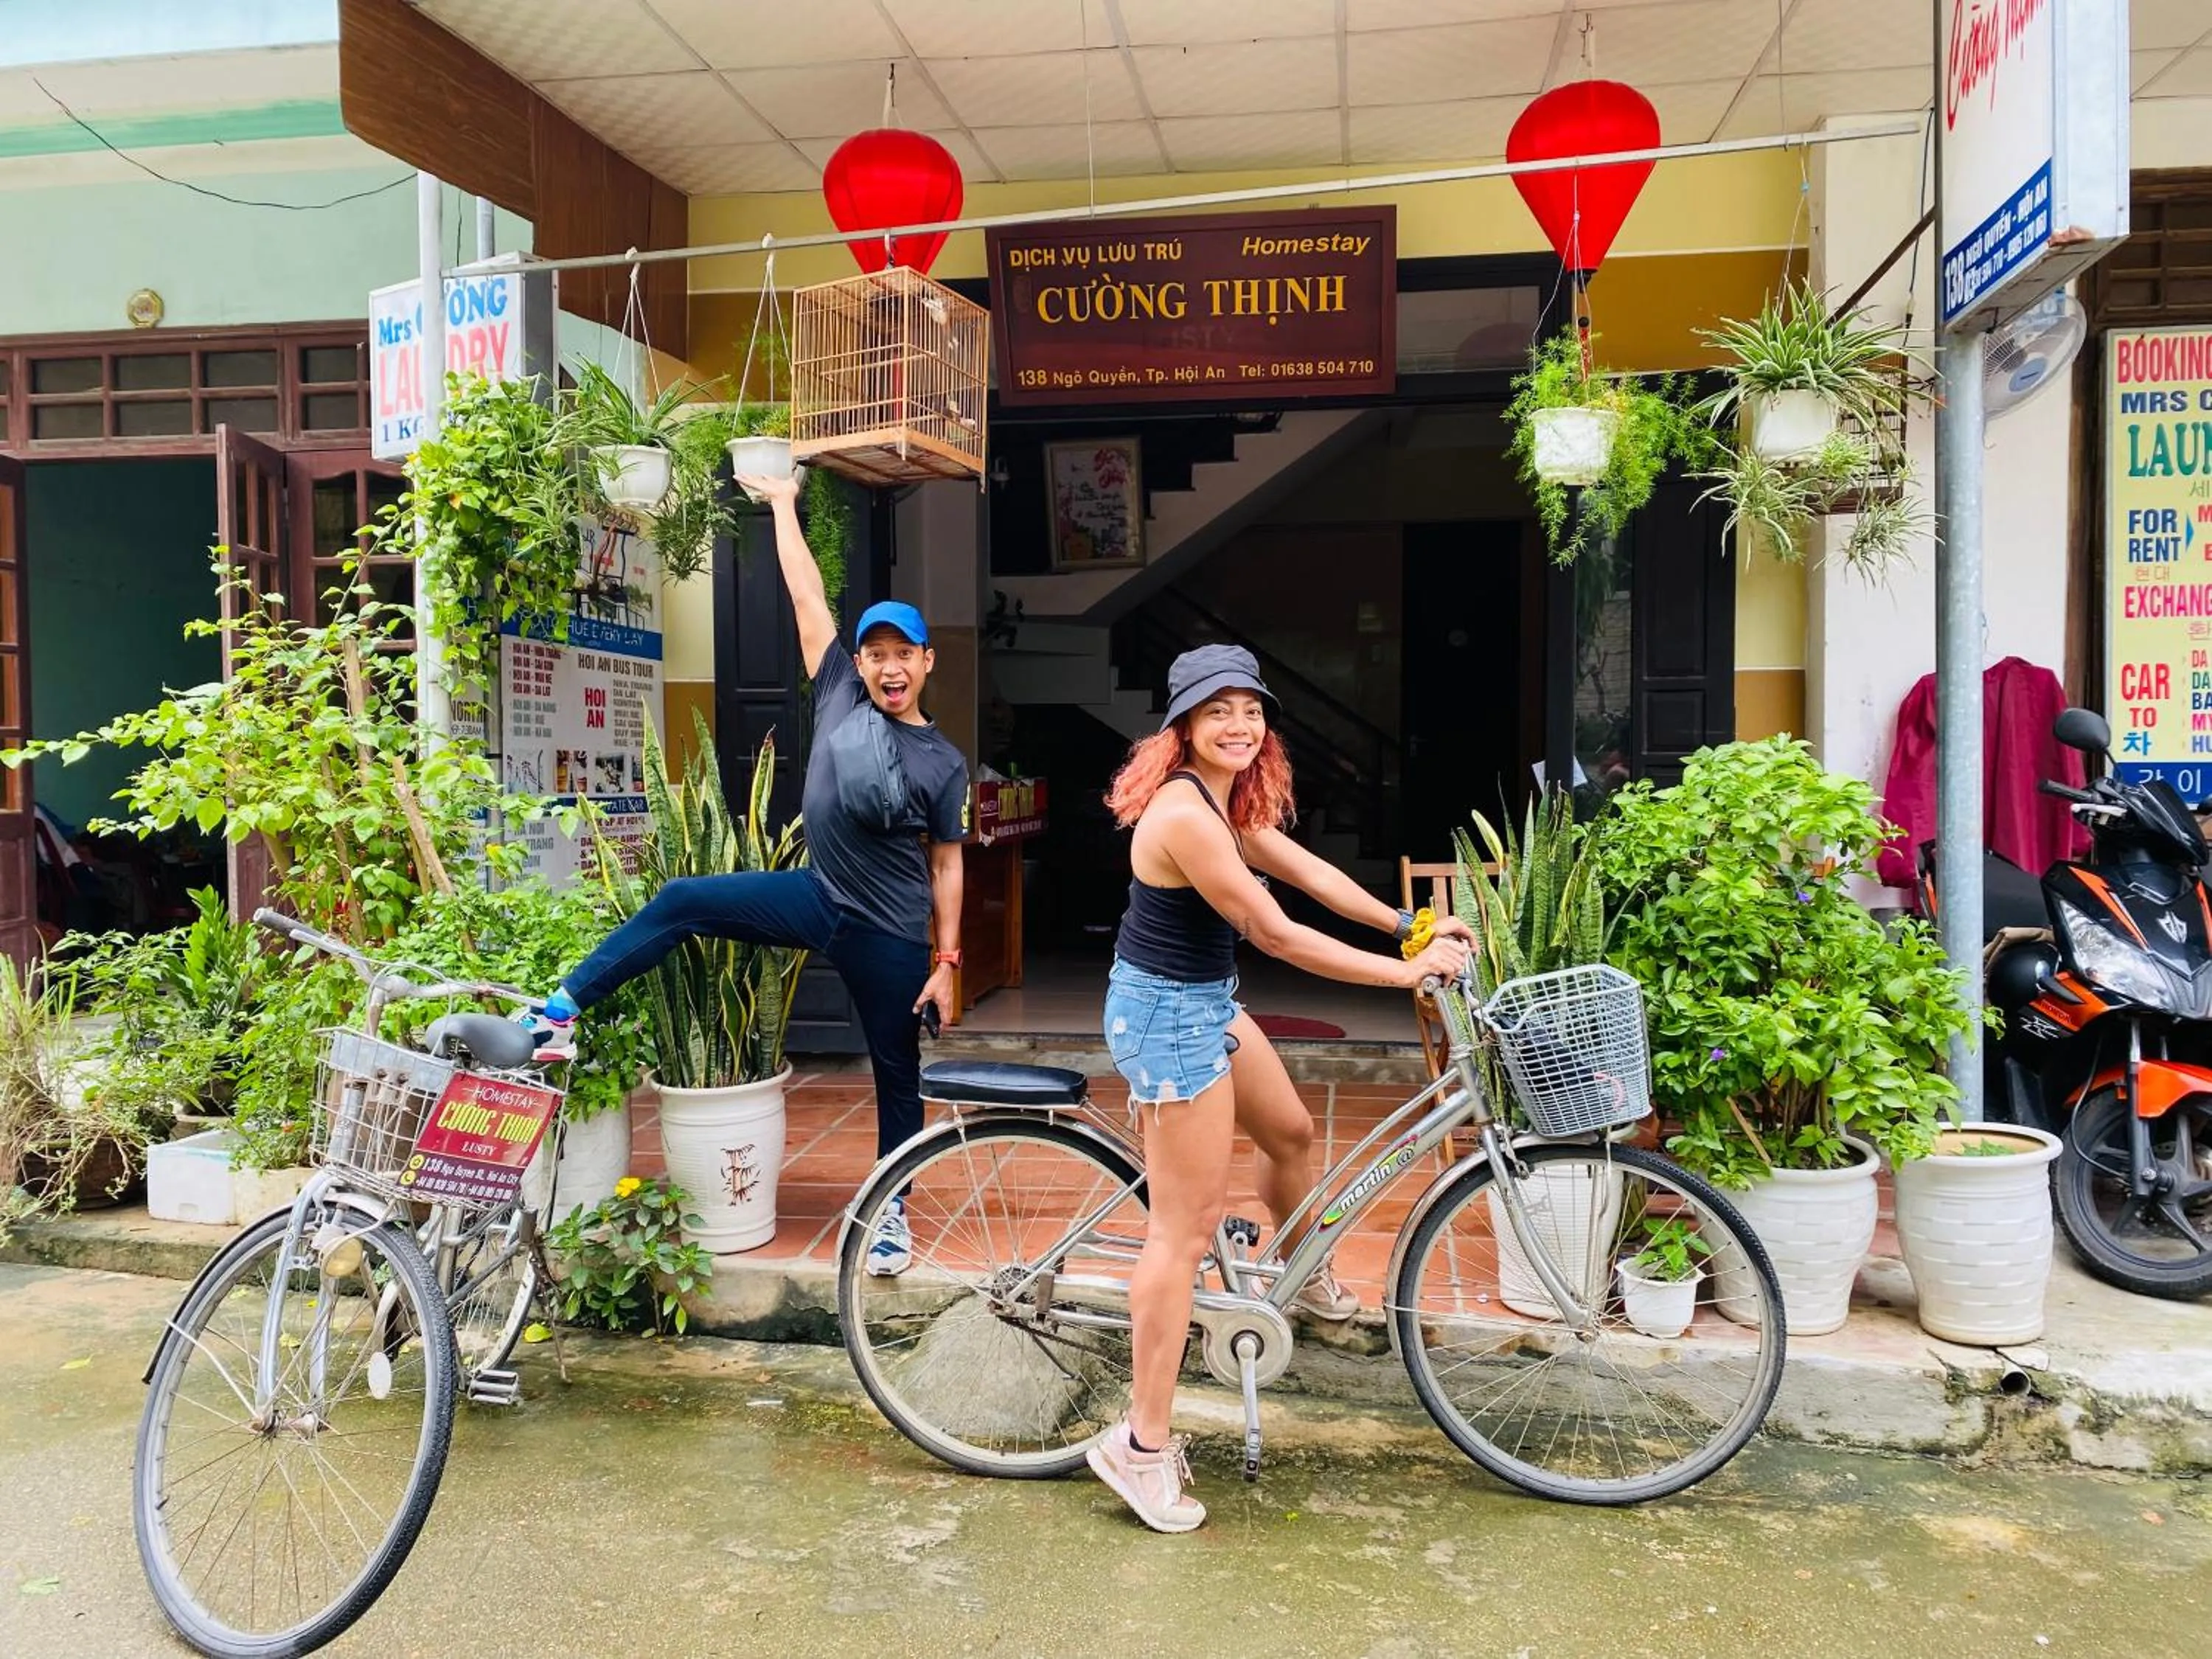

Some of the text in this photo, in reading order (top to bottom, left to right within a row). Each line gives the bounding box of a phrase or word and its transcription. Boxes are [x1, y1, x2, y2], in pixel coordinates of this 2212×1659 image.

[1009, 236, 1183, 271] DỊCH VỤ LƯU TRÚ
[1241, 232, 1371, 257] Homestay
[1945, 251, 1964, 311] 138
[1037, 273, 1348, 325] CƯỜNG THỊNH
[378, 316, 411, 347] Mrs
[1018, 369, 1048, 387] 138
[1089, 366, 1141, 386] Quyền,
[1145, 367, 1169, 383] Tp.
[1175, 366, 1199, 383] Hội
[1206, 366, 1225, 380] An
[1239, 365, 1266, 378] Tel:
[1271, 363, 1314, 377] 01638
[1318, 361, 1345, 375] 504
[1349, 359, 1374, 374] 710
[2121, 389, 2188, 414] MRS
[2128, 508, 2178, 535] FOR
[2128, 536, 2183, 563] RENT
[578, 653, 654, 679] HOI AN BUS TOUR
[2121, 663, 2170, 700] CAR
[584, 686, 606, 708] HOI
[586, 709, 605, 728] AN
[2129, 708, 2157, 728] TO
[2123, 731, 2152, 757] 차
[473, 1085, 536, 1109] HOMESTAY
[462, 1141, 499, 1157] LUSTY
[422, 1158, 443, 1172] 138
[1340, 1163, 1394, 1211] martin
